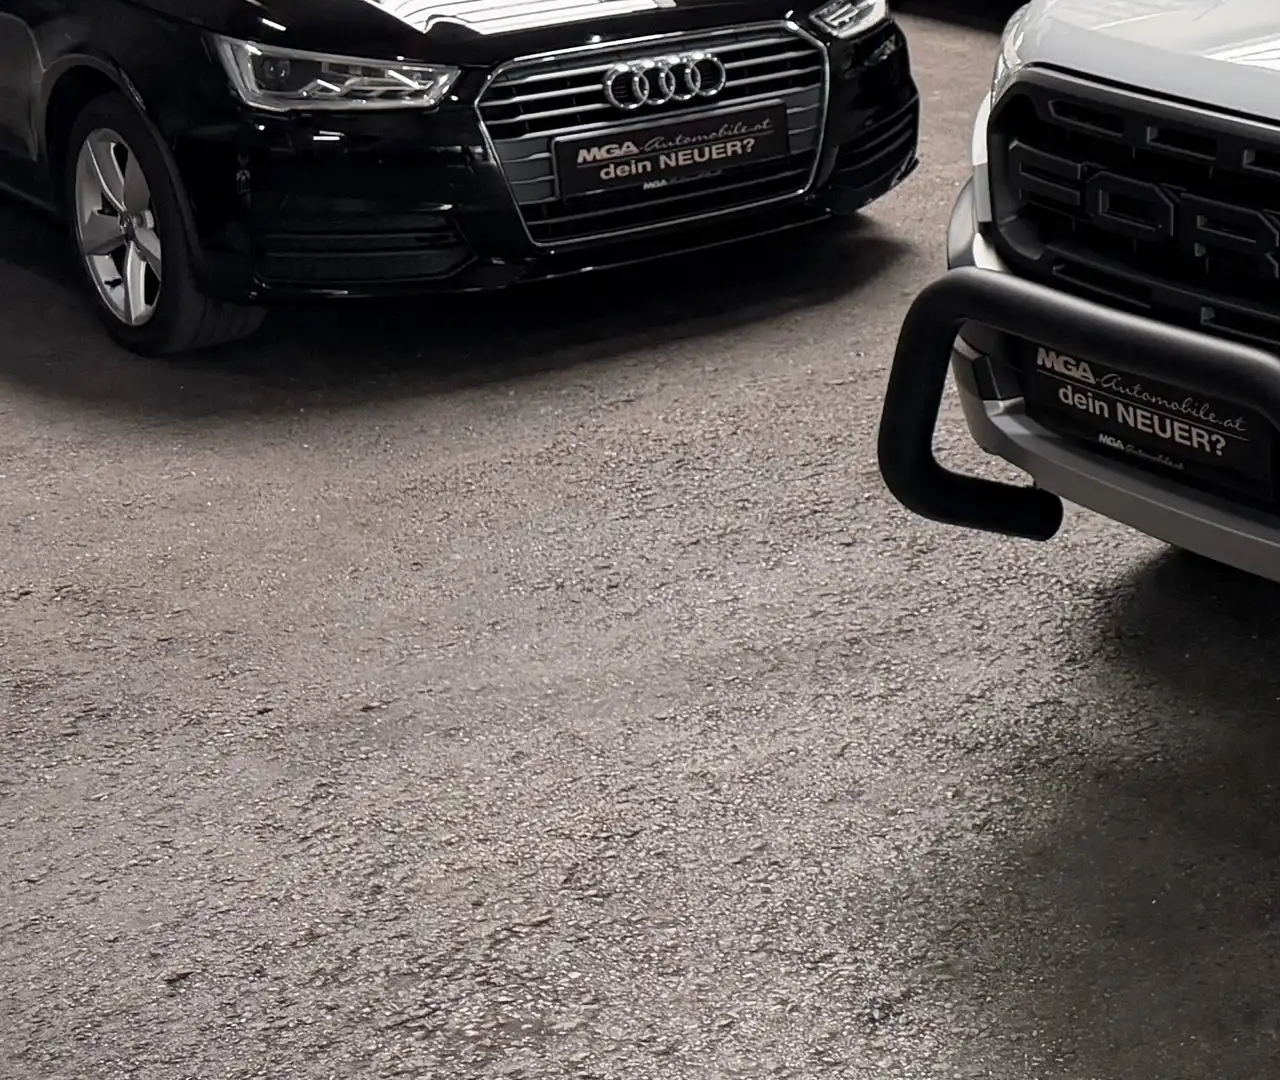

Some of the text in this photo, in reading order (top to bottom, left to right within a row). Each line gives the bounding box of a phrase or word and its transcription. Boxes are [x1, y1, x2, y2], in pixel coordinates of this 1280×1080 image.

[600, 160, 652, 180] dein
[659, 138, 756, 169] NEUER?
[1058, 385, 1227, 456] dein NEUER?
